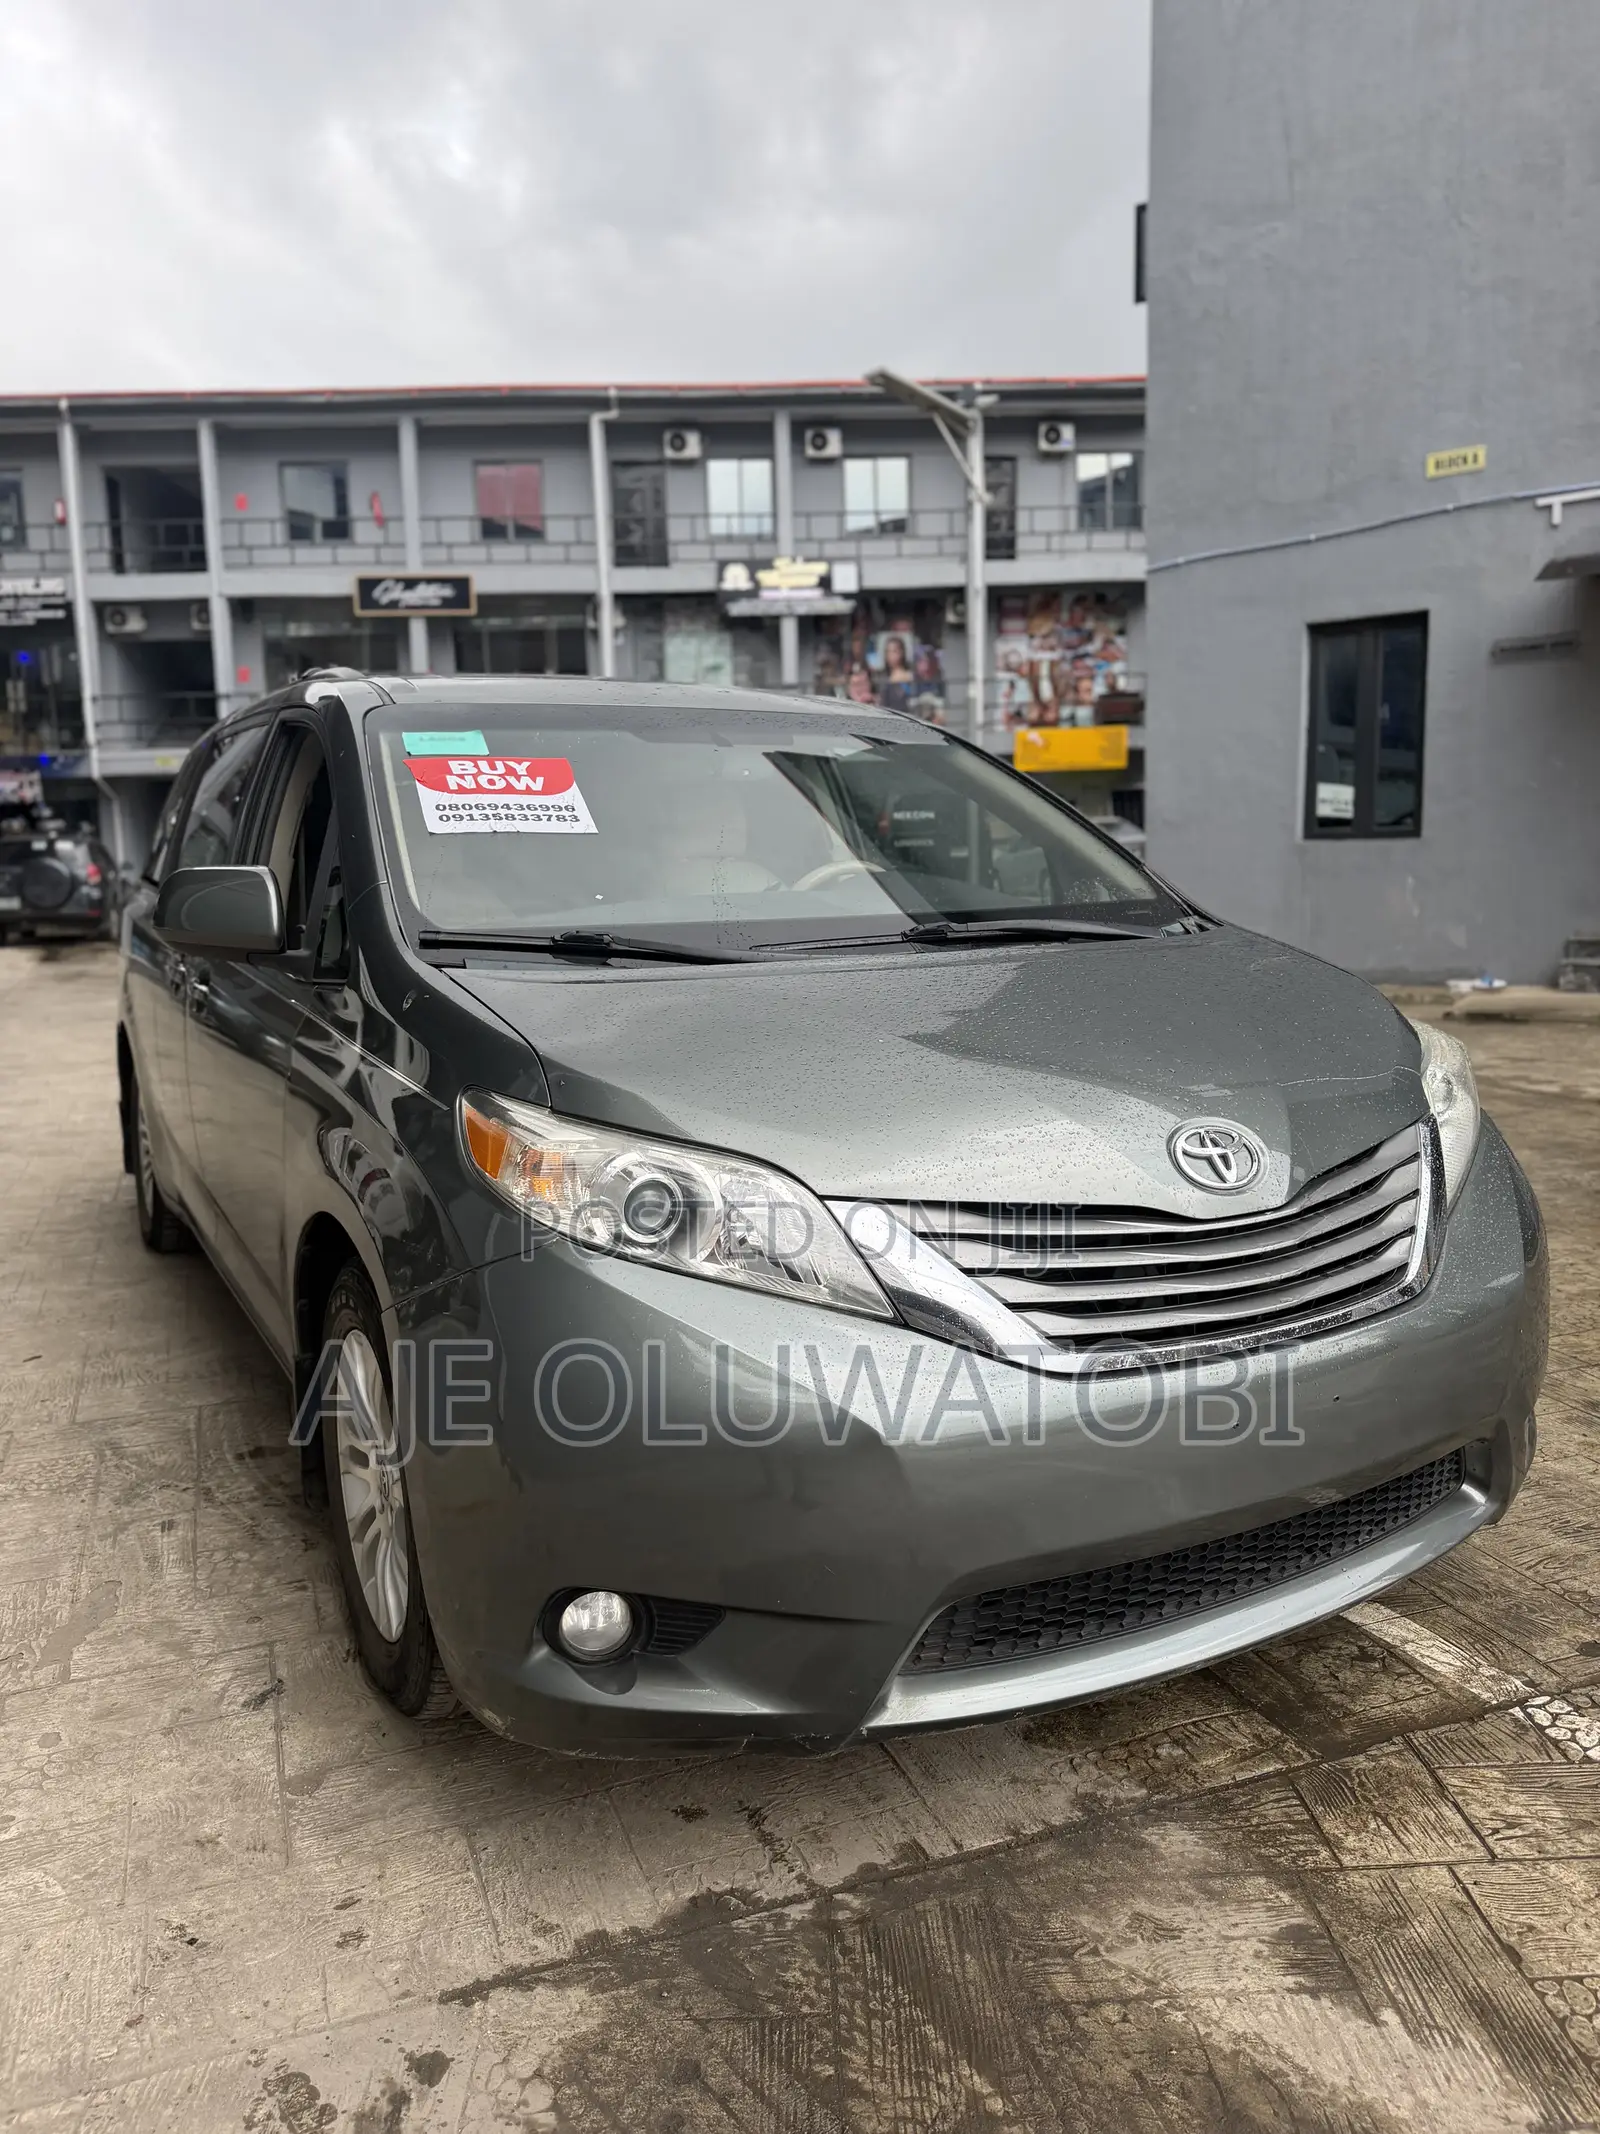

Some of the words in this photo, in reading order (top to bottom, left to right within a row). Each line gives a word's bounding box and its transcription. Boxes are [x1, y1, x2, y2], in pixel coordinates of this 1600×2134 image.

[447, 760, 532, 775] BUY
[445, 774, 545, 791] NOW
[435, 803, 576, 812] 08069436996
[438, 813, 580, 822] 09135833783
